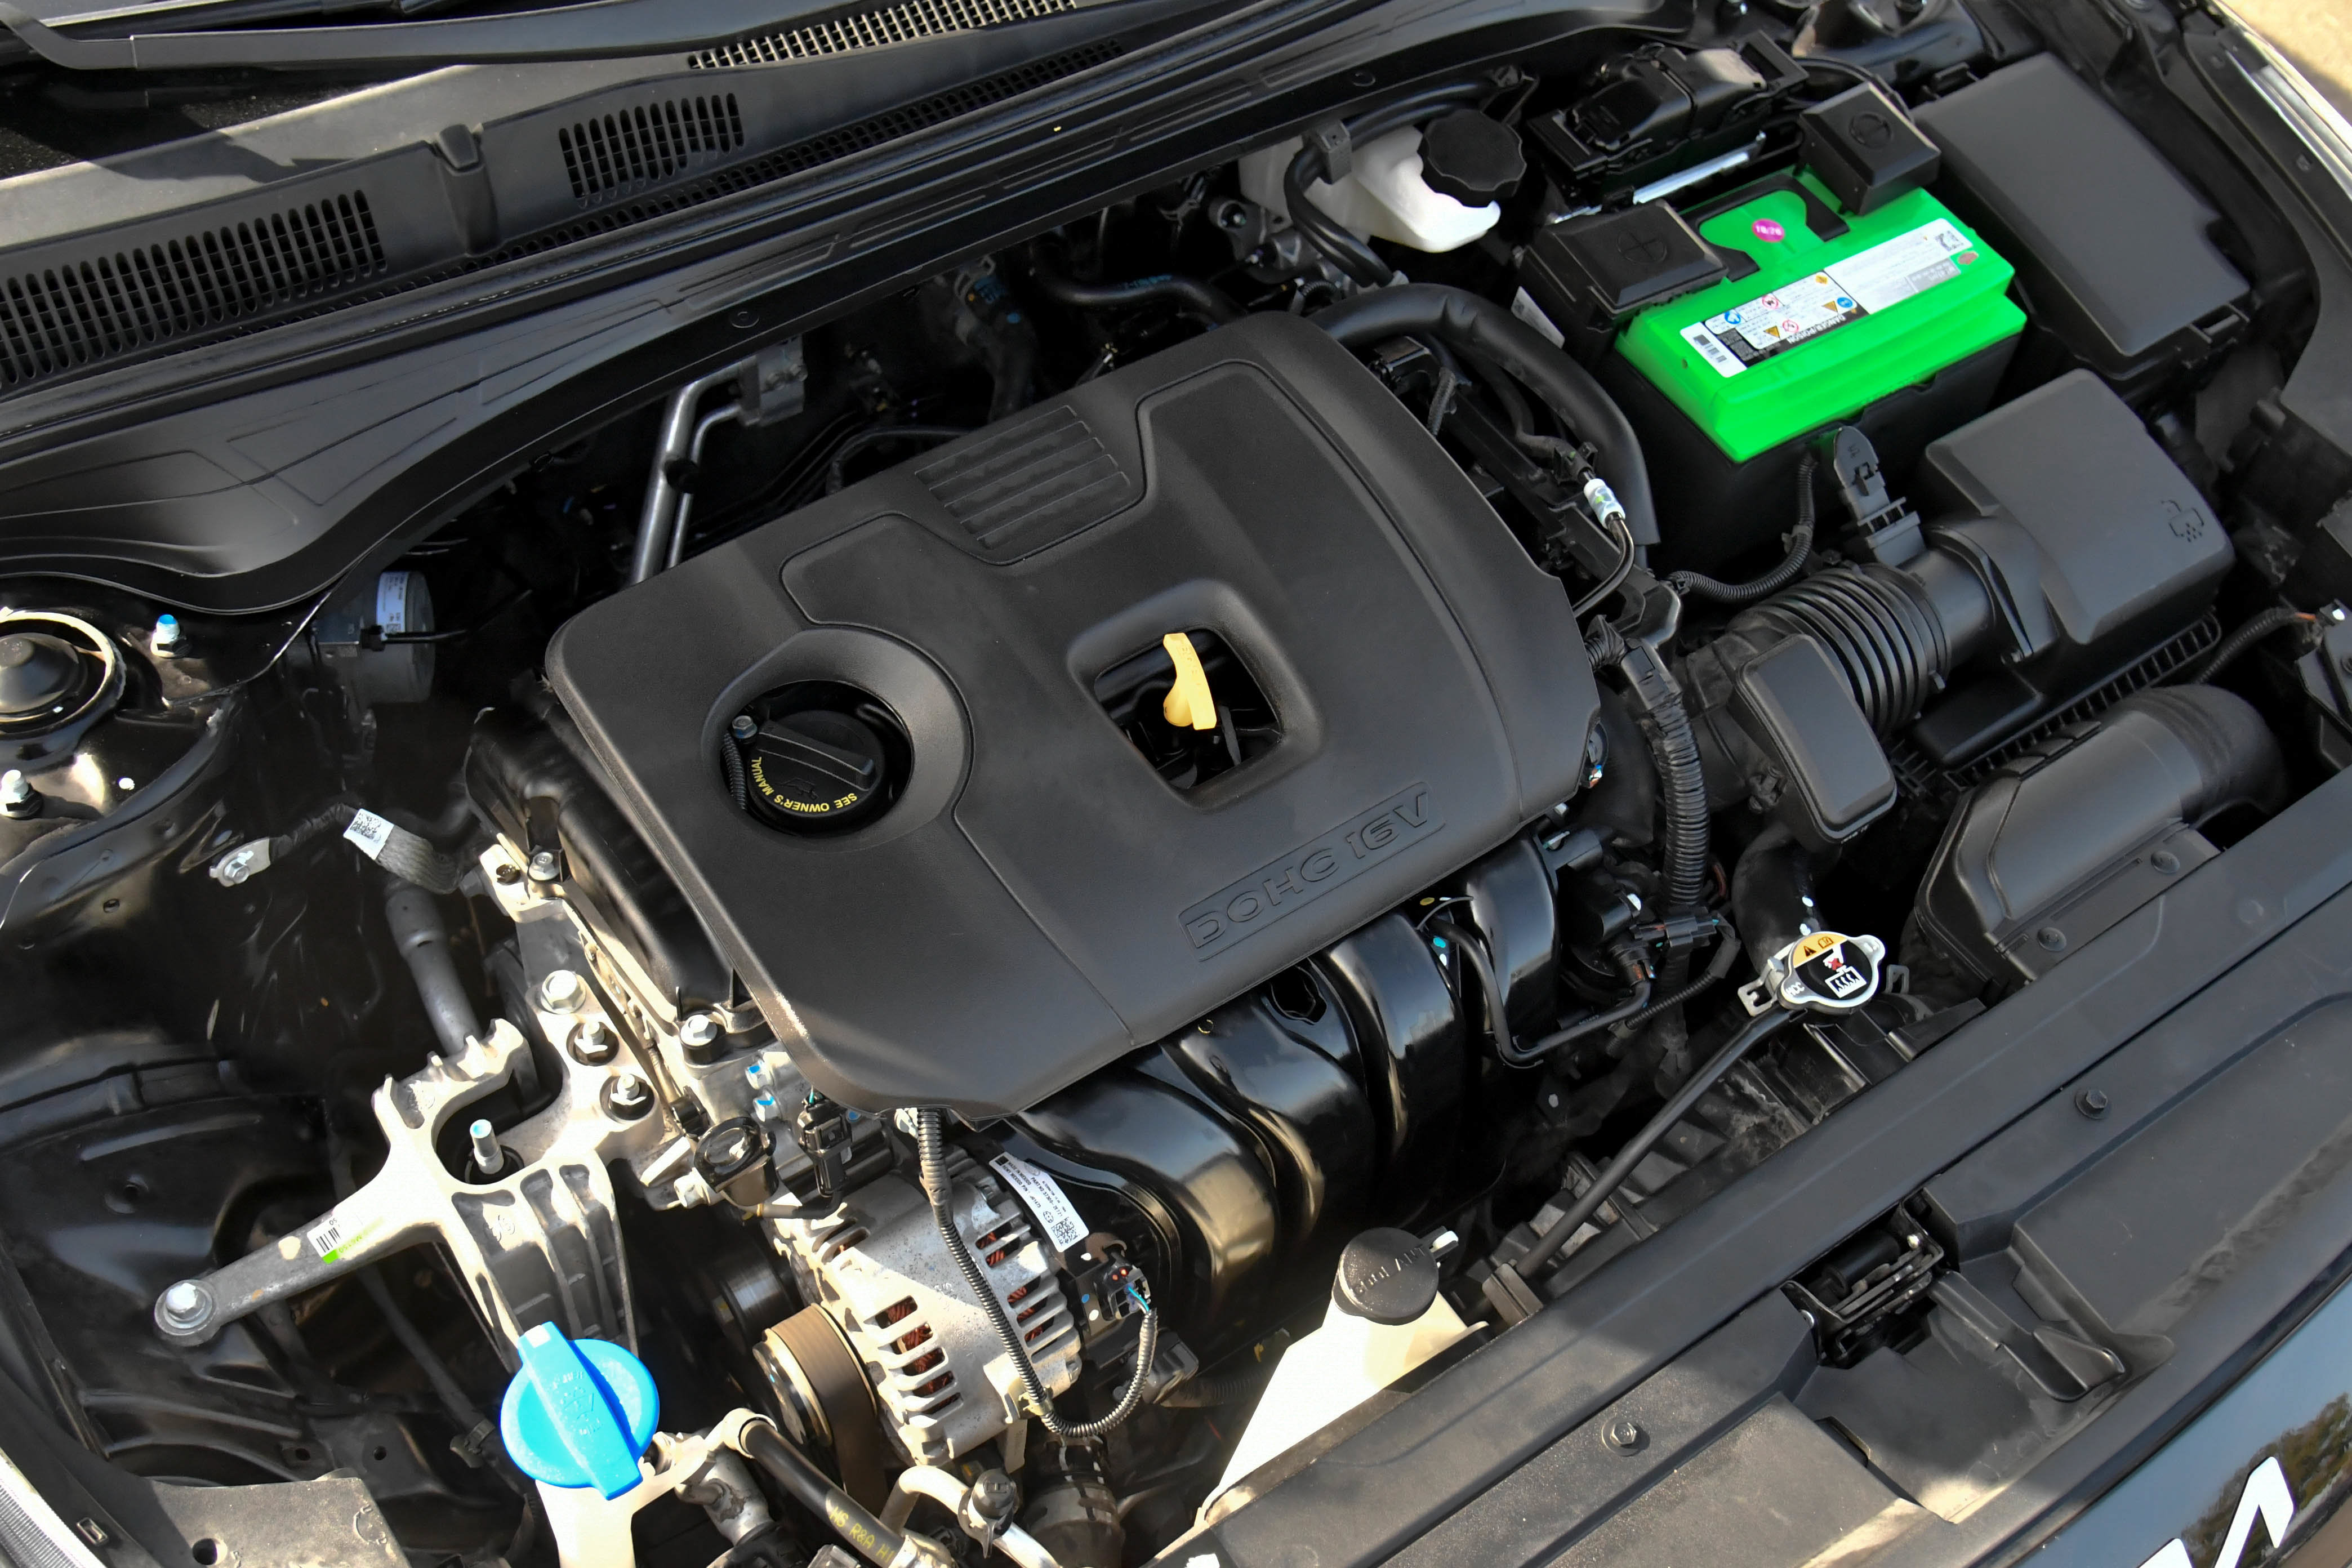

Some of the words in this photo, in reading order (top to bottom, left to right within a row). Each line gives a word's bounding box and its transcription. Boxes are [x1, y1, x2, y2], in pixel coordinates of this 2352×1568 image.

[751, 756, 775, 796] MANUAL
[774, 794, 830, 812] OWNER'S
[834, 792, 857, 809] SEE
[1185, 847, 1339, 948] DOHC
[1345, 791, 1429, 859] 16V
[829, 1506, 849, 1527] HS
[849, 1522, 875, 1549] R&A
